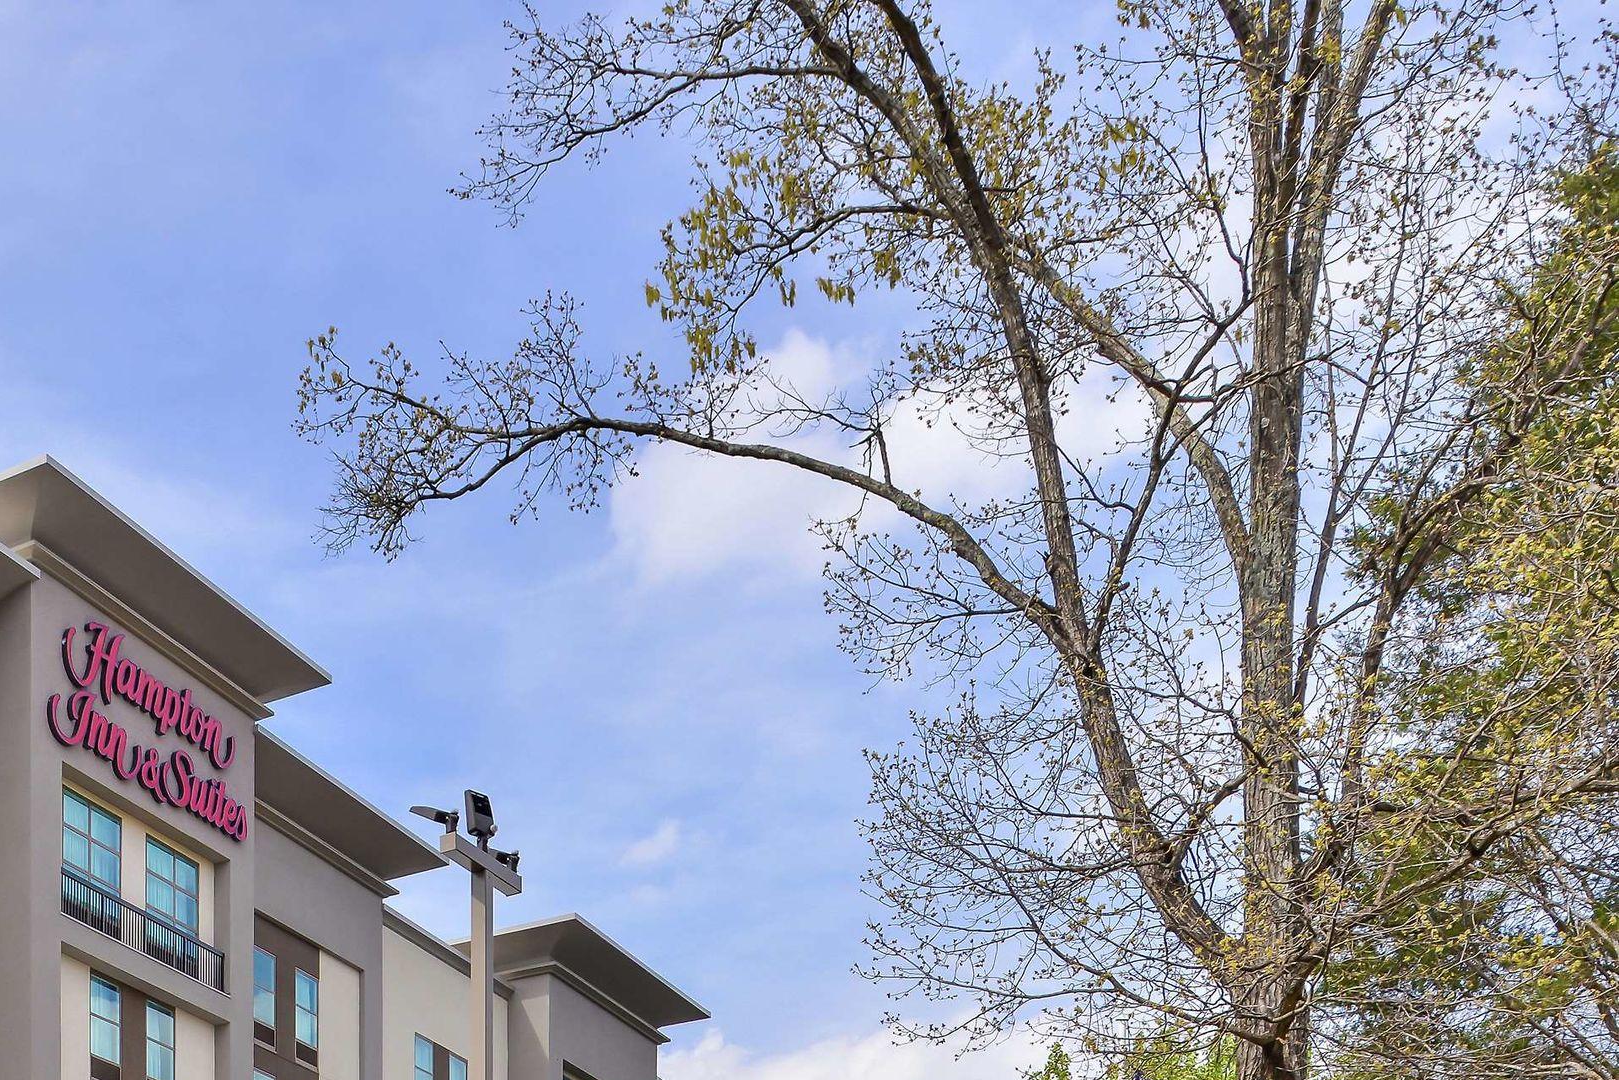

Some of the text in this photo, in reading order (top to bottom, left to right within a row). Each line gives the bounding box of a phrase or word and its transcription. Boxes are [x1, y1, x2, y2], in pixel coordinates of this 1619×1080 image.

[47, 691, 249, 842] Inn & Suites
[62, 621, 236, 769] Hampton
